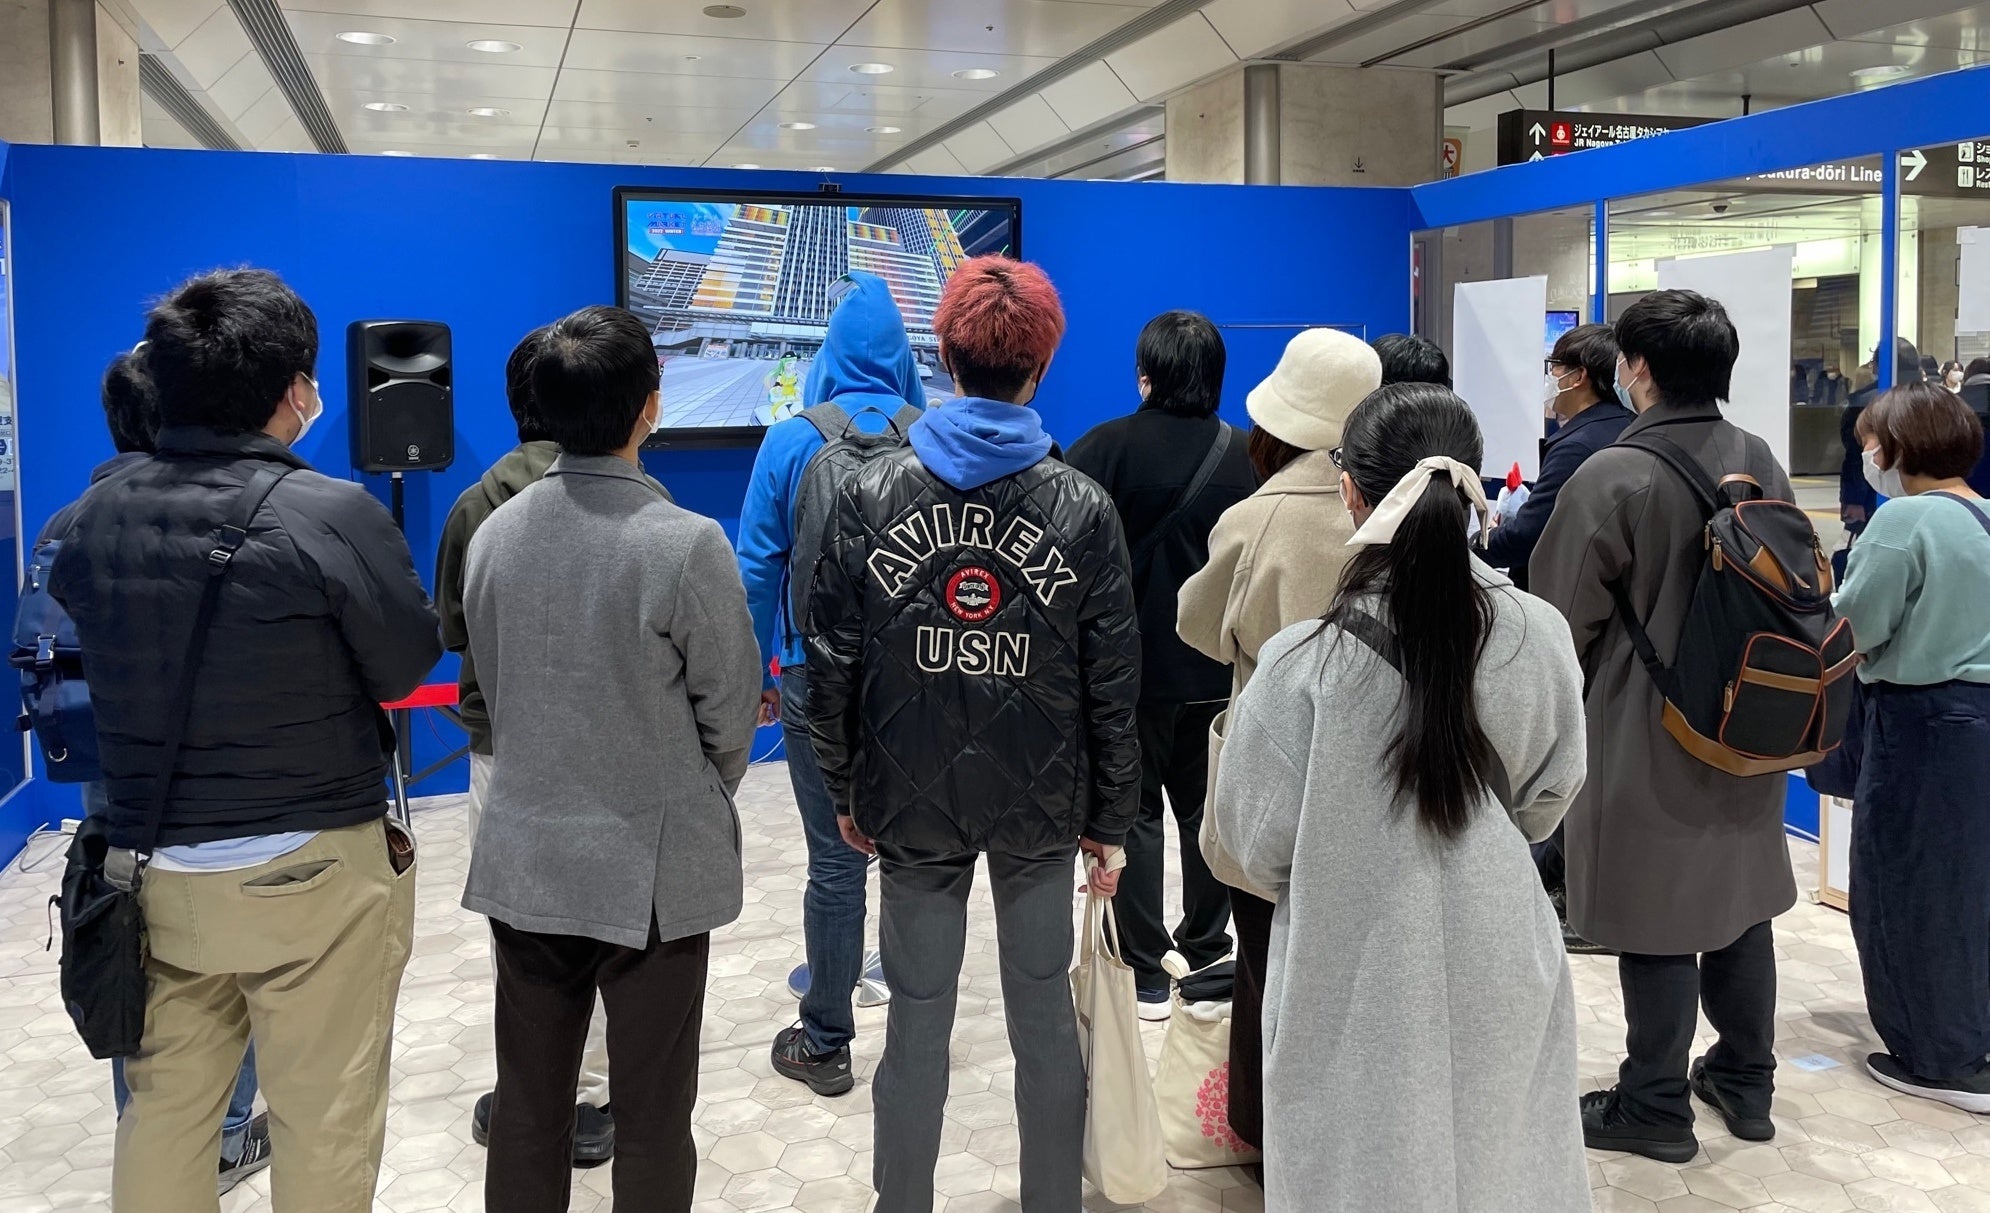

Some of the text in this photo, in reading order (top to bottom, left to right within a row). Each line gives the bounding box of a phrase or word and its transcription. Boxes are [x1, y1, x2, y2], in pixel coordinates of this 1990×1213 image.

[1574, 138, 1585, 147] JR
[1850, 166, 1883, 182] Line
[867, 502, 1078, 606] AVIREX
[960, 568, 990, 580] AVIREX
[950, 601, 964, 615] NEW
[965, 611, 983, 619] YORK
[916, 625, 1030, 677] USN
